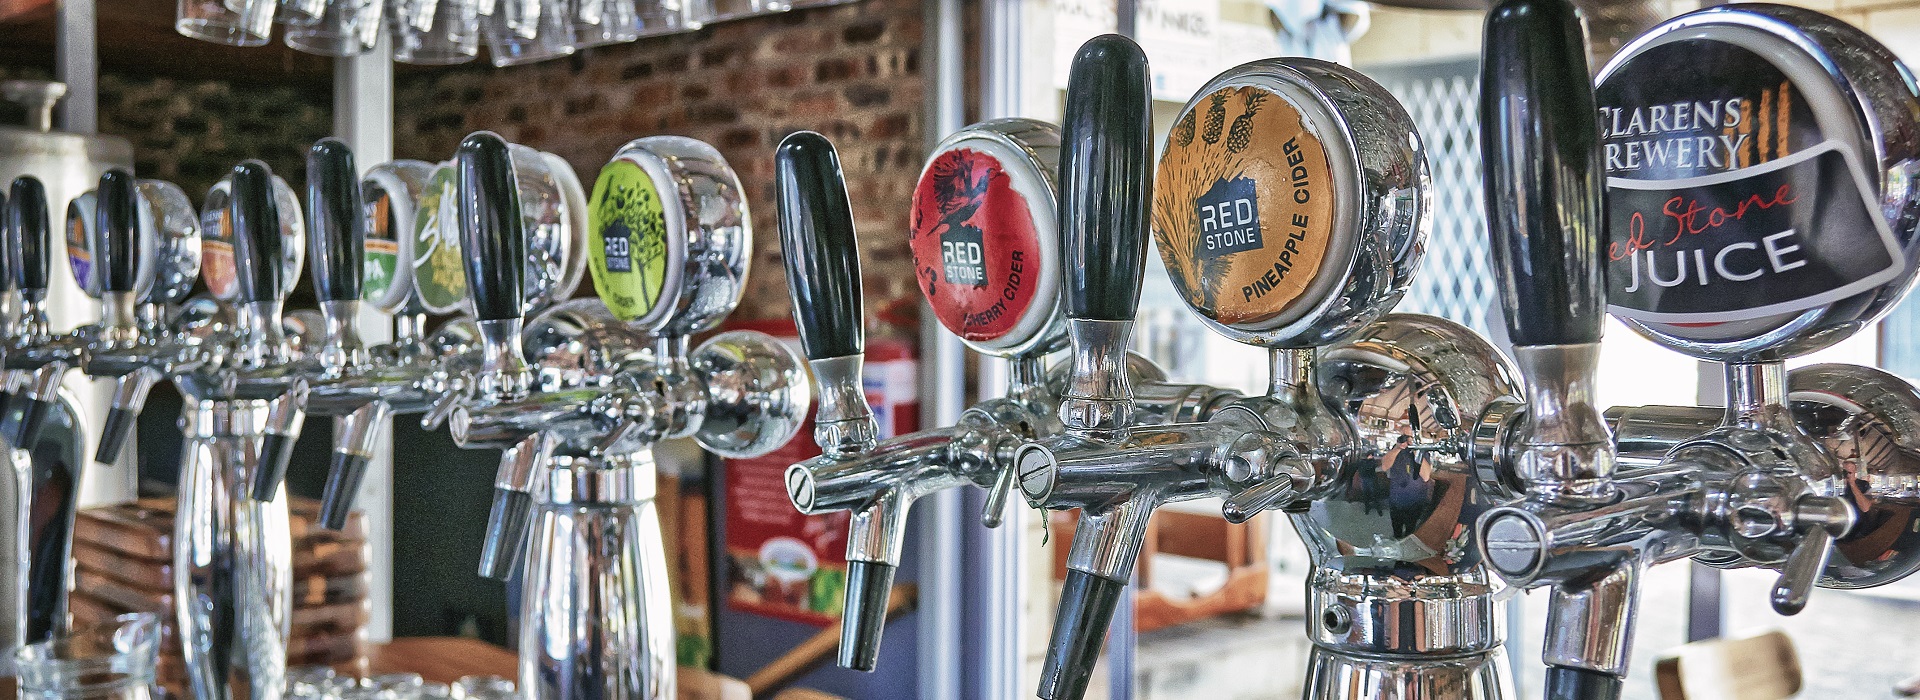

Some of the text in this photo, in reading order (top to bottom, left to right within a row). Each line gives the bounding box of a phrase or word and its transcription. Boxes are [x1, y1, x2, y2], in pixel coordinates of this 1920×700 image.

[1605, 133, 1749, 171] REWERY
[1202, 198, 1253, 231] RED
[1241, 136, 1310, 302] PINEAPPLE CIDER
[1608, 184, 1799, 262] ed Stone
[605, 236, 629, 256] RED
[942, 241, 981, 264] RED
[1206, 227, 1256, 250] STONE
[946, 265, 983, 280] STONE
[1003, 250, 1024, 301] CIDER
[1625, 228, 1808, 293] JUICE
